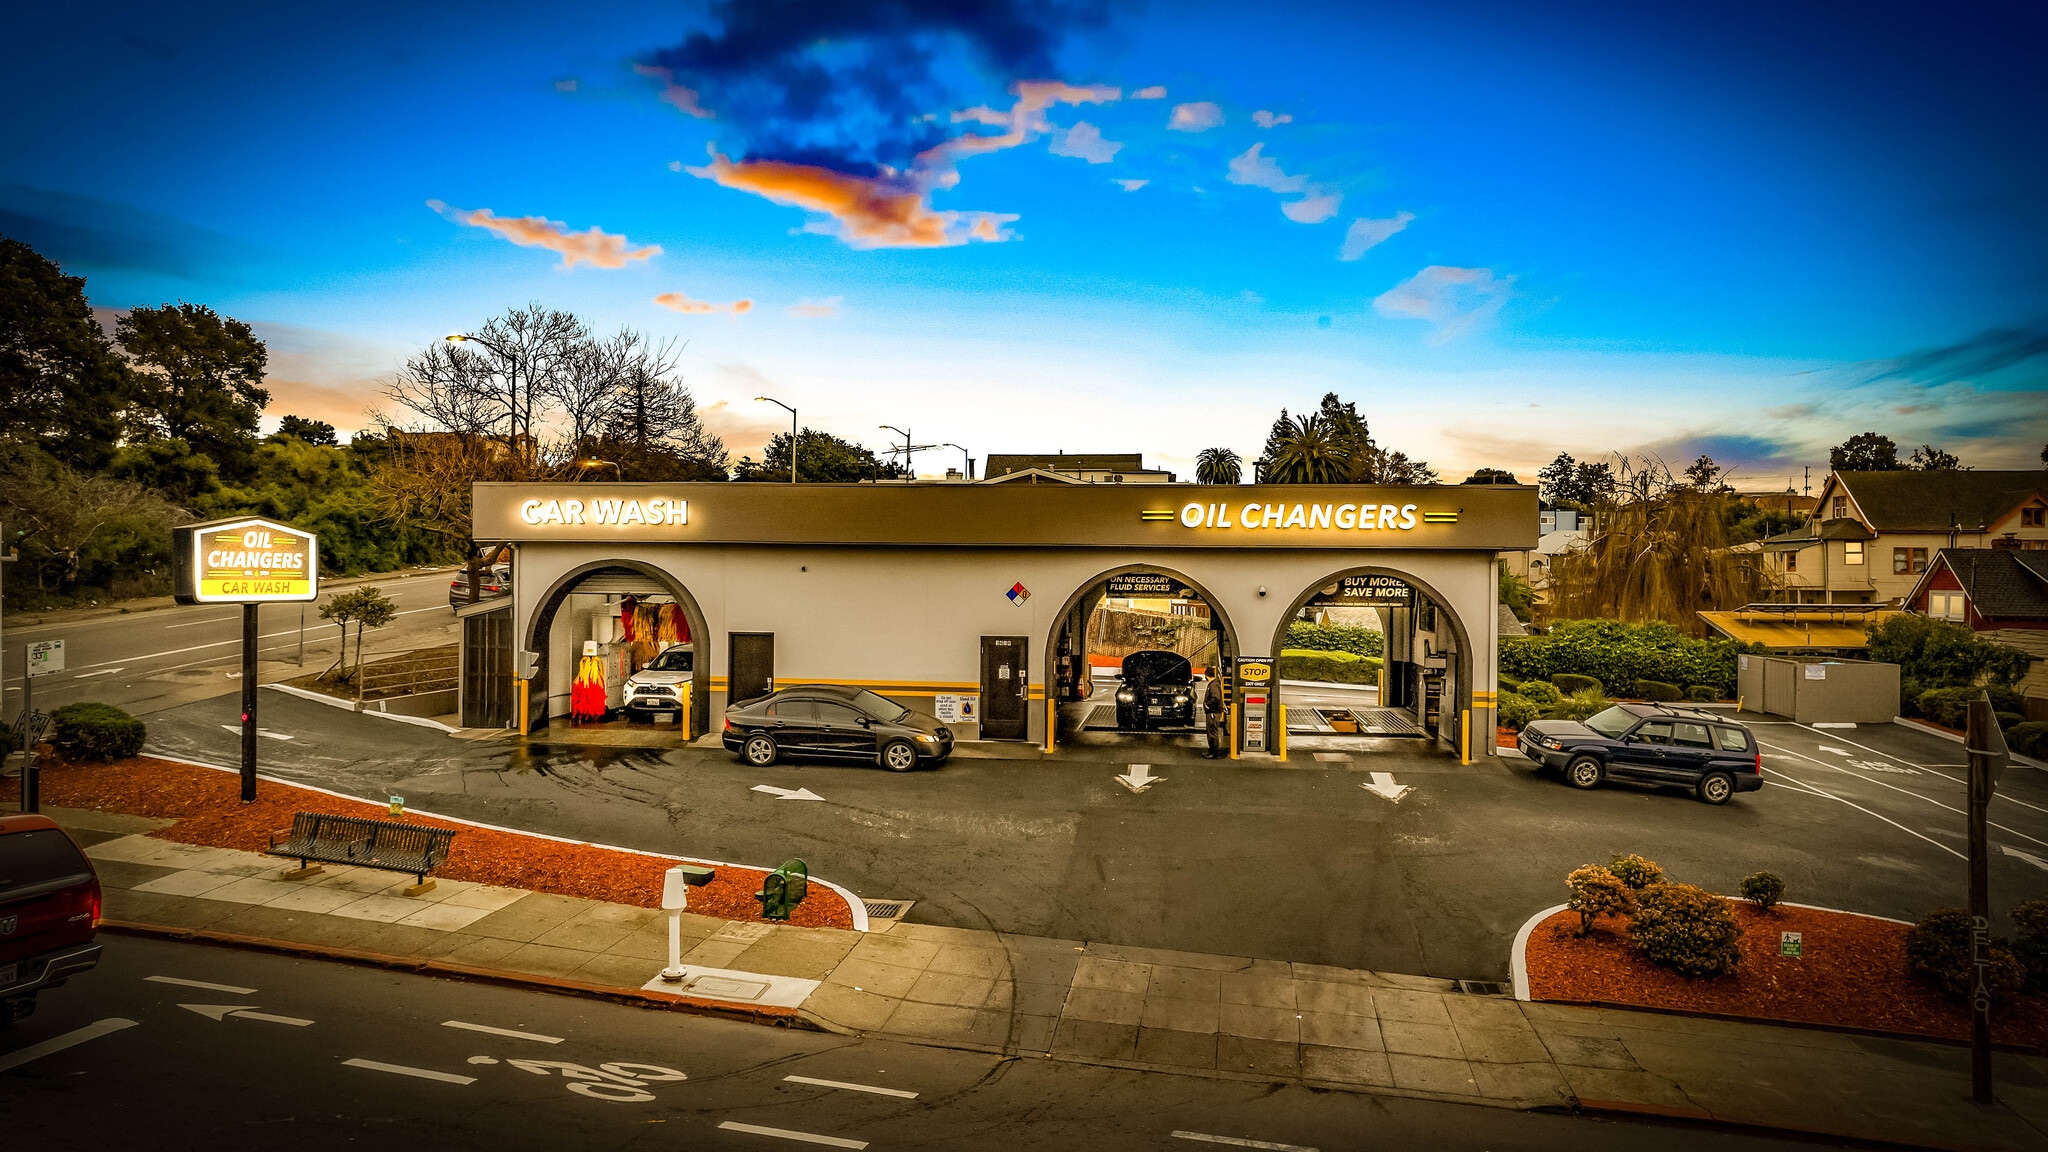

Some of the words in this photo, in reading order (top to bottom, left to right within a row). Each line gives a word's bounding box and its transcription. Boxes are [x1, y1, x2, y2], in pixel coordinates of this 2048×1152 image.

[521, 500, 584, 524] CAR
[592, 500, 688, 525] WASH
[1180, 502, 1232, 528] OIL
[1240, 504, 1417, 530] CHANGERS
[244, 532, 272, 548] OIL
[208, 550, 303, 568] CHANGERS
[222, 582, 248, 594] CAR
[254, 582, 290, 593] WASH
[1345, 578, 1367, 586] BUY
[1344, 588, 1372, 596] SAVE
[1376, 588, 1409, 597] MORE
